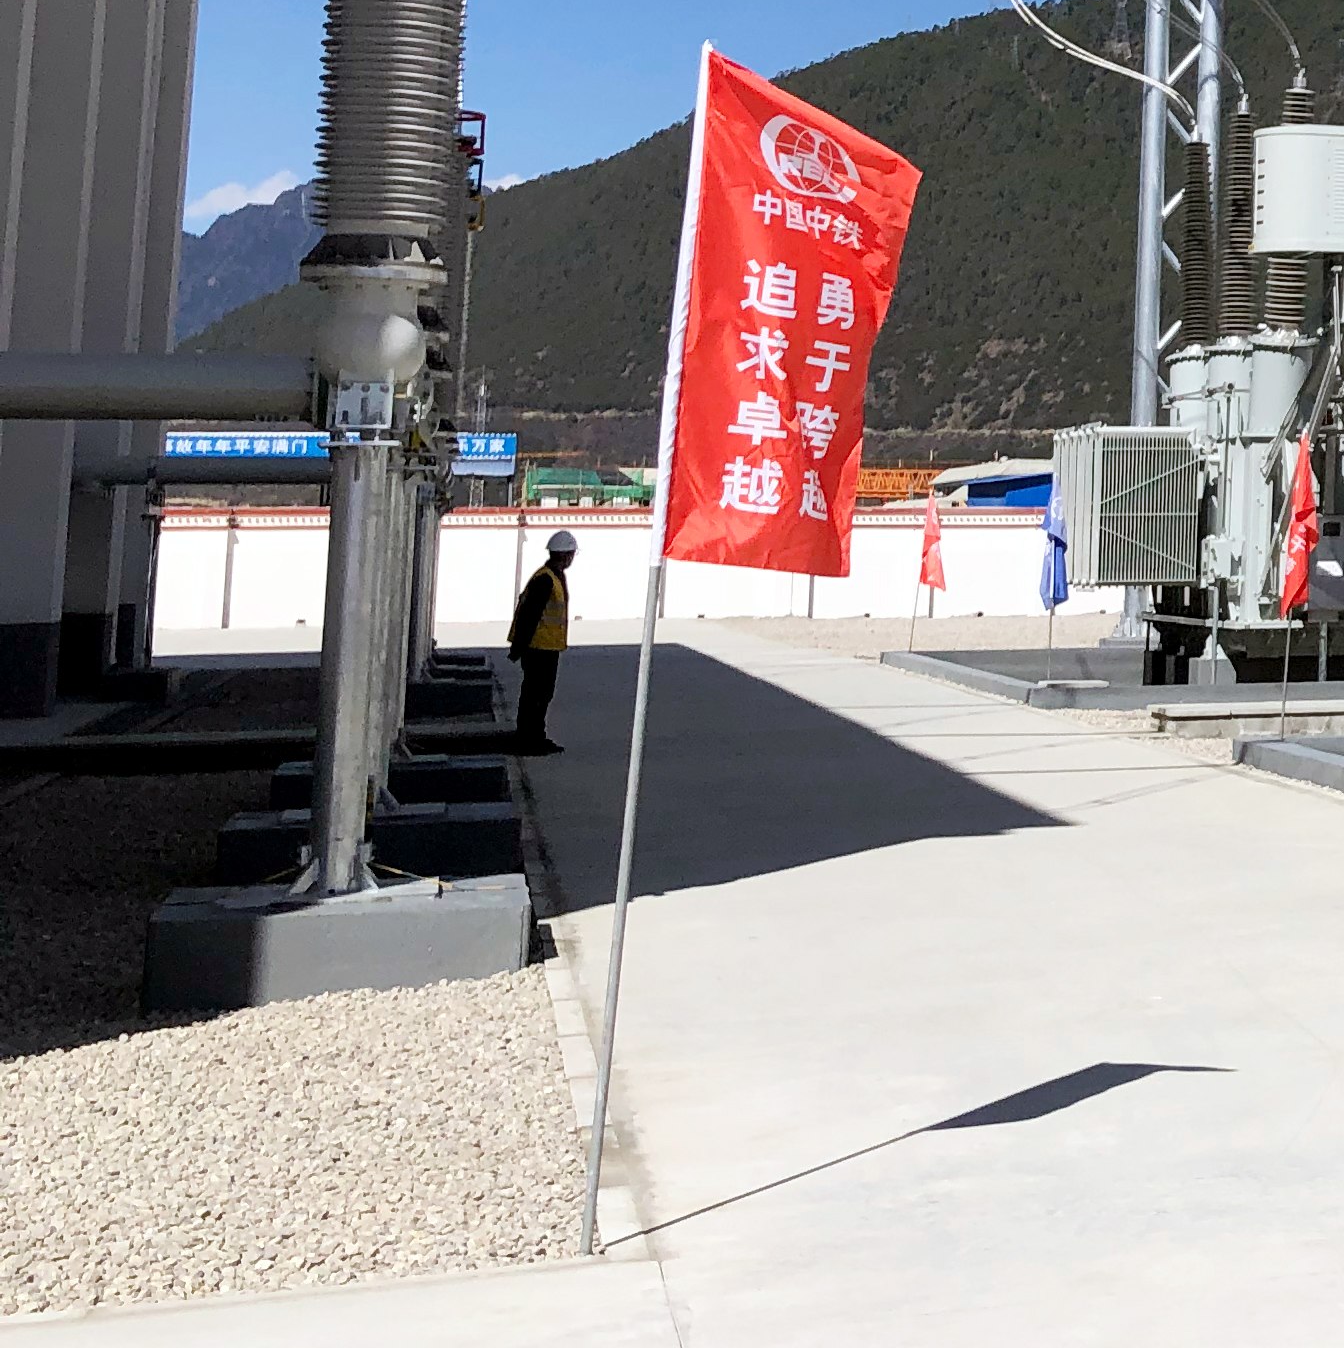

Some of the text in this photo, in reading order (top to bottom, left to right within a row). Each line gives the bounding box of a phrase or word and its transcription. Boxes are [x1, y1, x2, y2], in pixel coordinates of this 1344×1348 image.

[752, 189, 864, 251] 中国中铁
[719, 258, 798, 515] 追求卓越
